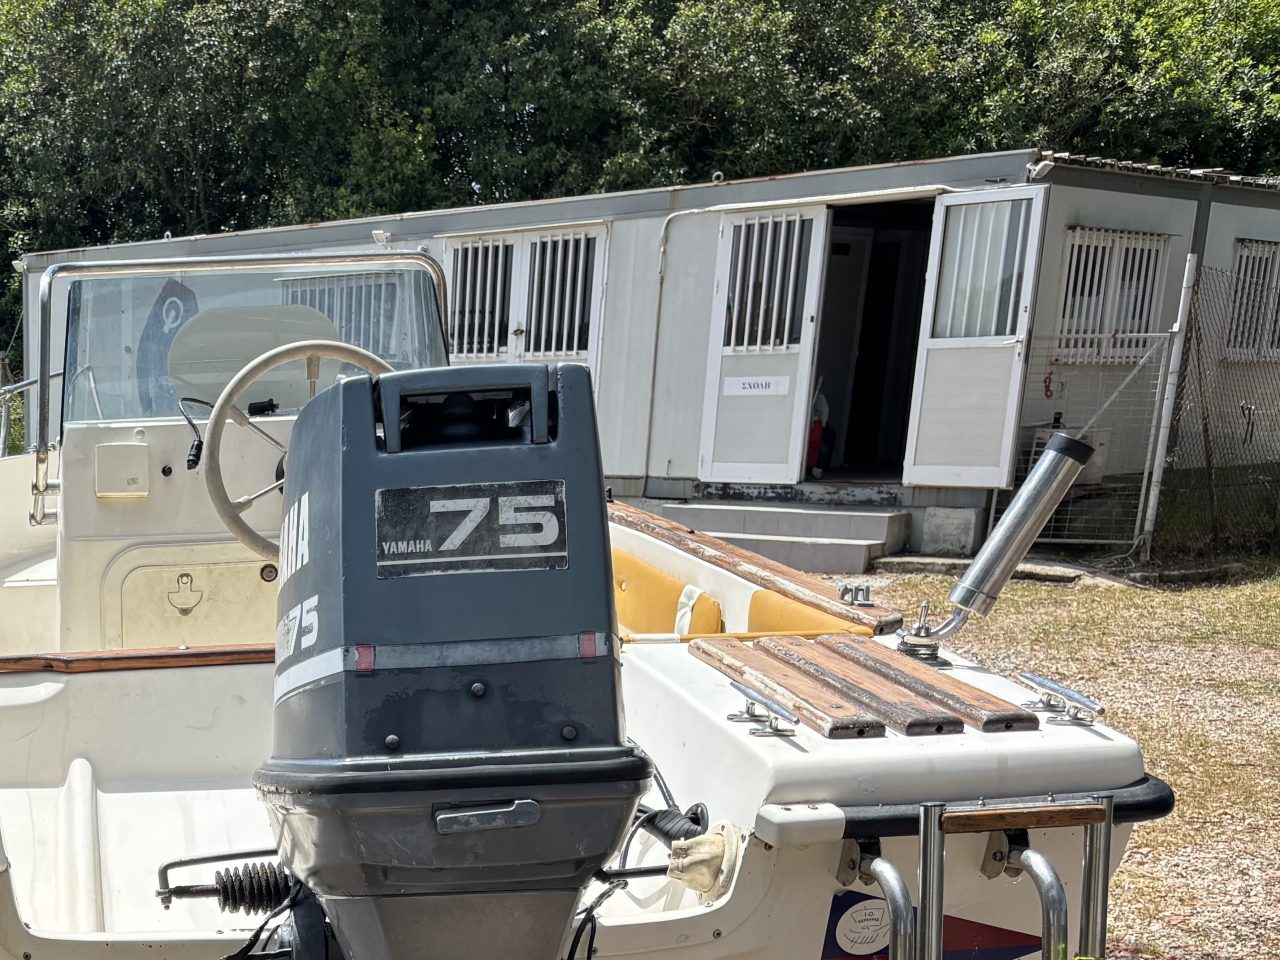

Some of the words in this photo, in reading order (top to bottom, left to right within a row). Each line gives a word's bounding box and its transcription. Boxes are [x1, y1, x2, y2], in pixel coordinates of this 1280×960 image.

[741, 381, 771, 390] ΣΧΟΛΗ
[382, 540, 433, 555] YAMAHA
[430, 495, 559, 551] 75
[289, 595, 319, 656] 75
